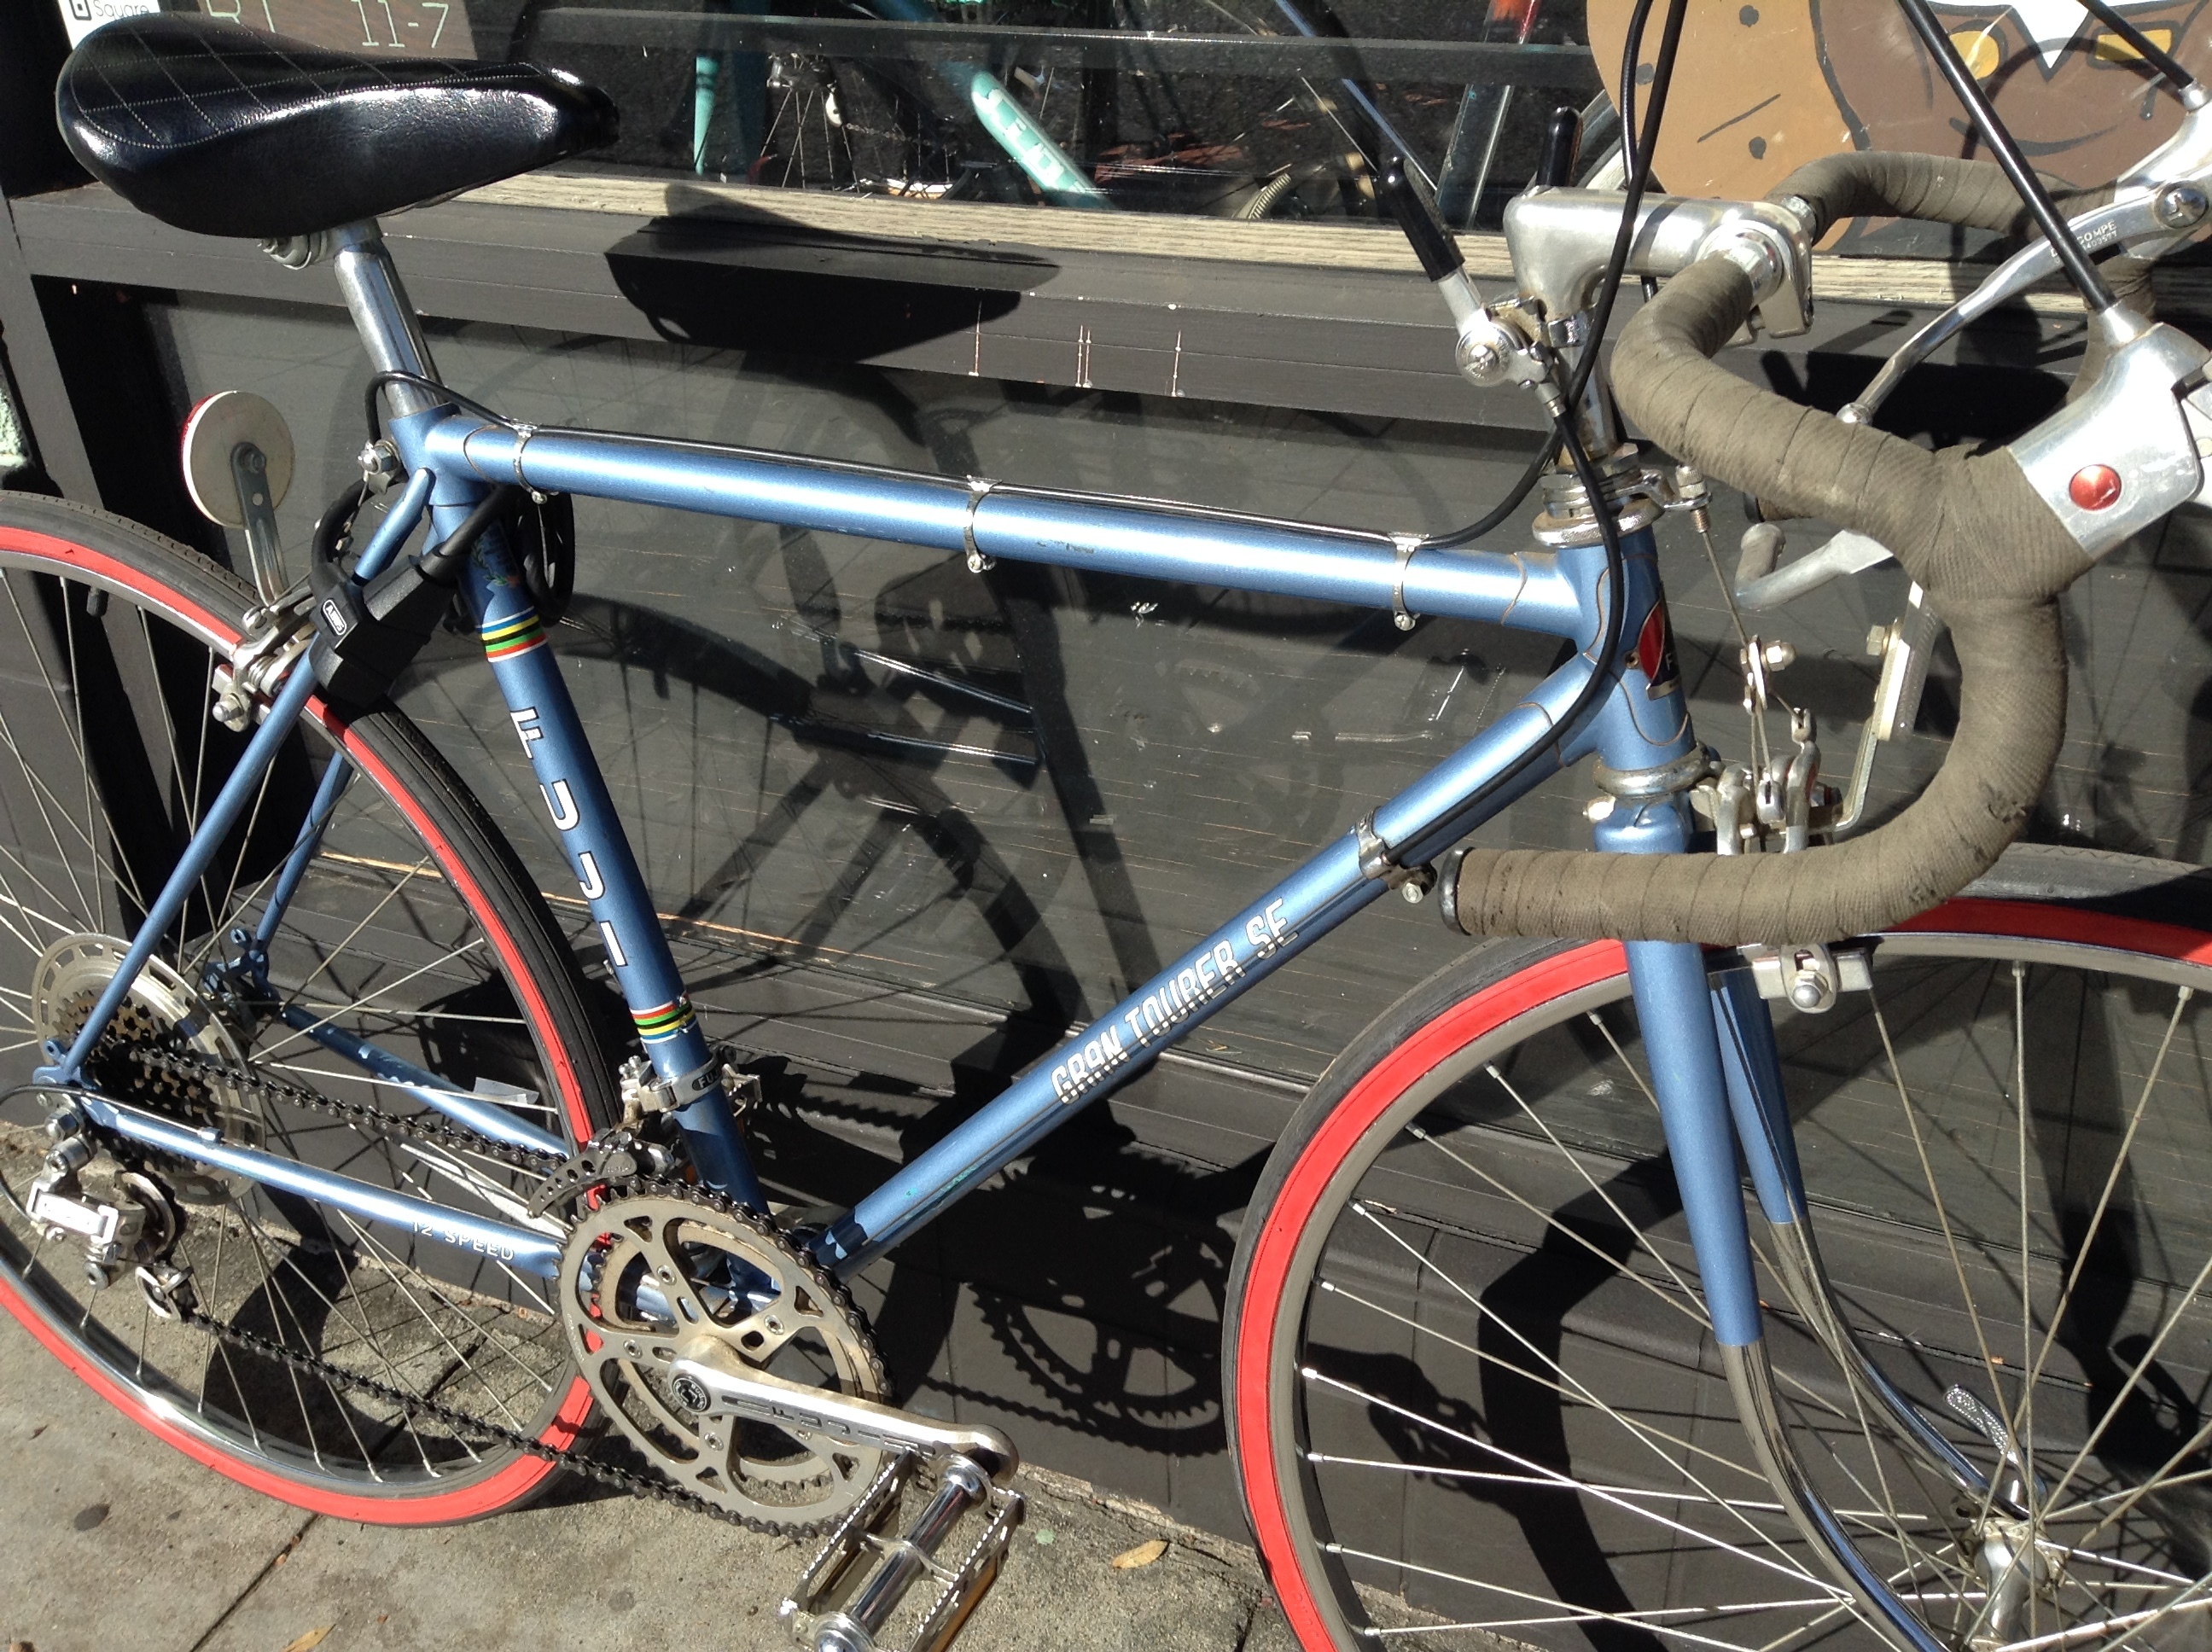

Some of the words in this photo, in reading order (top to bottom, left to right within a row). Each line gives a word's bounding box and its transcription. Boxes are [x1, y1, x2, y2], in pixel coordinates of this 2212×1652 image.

[95, 0, 149, 19] Square
[351, 0, 448, 48] 11-7
[510, 707, 627, 968] FUJI
[1051, 1025, 1131, 1104] GRAN
[1124, 939, 1246, 1048] TOURER
[1245, 898, 1299, 960] SE
[412, 1220, 433, 1236] 12
[442, 1229, 514, 1261] SPEED
[771, 1406, 881, 1440] FUJI
